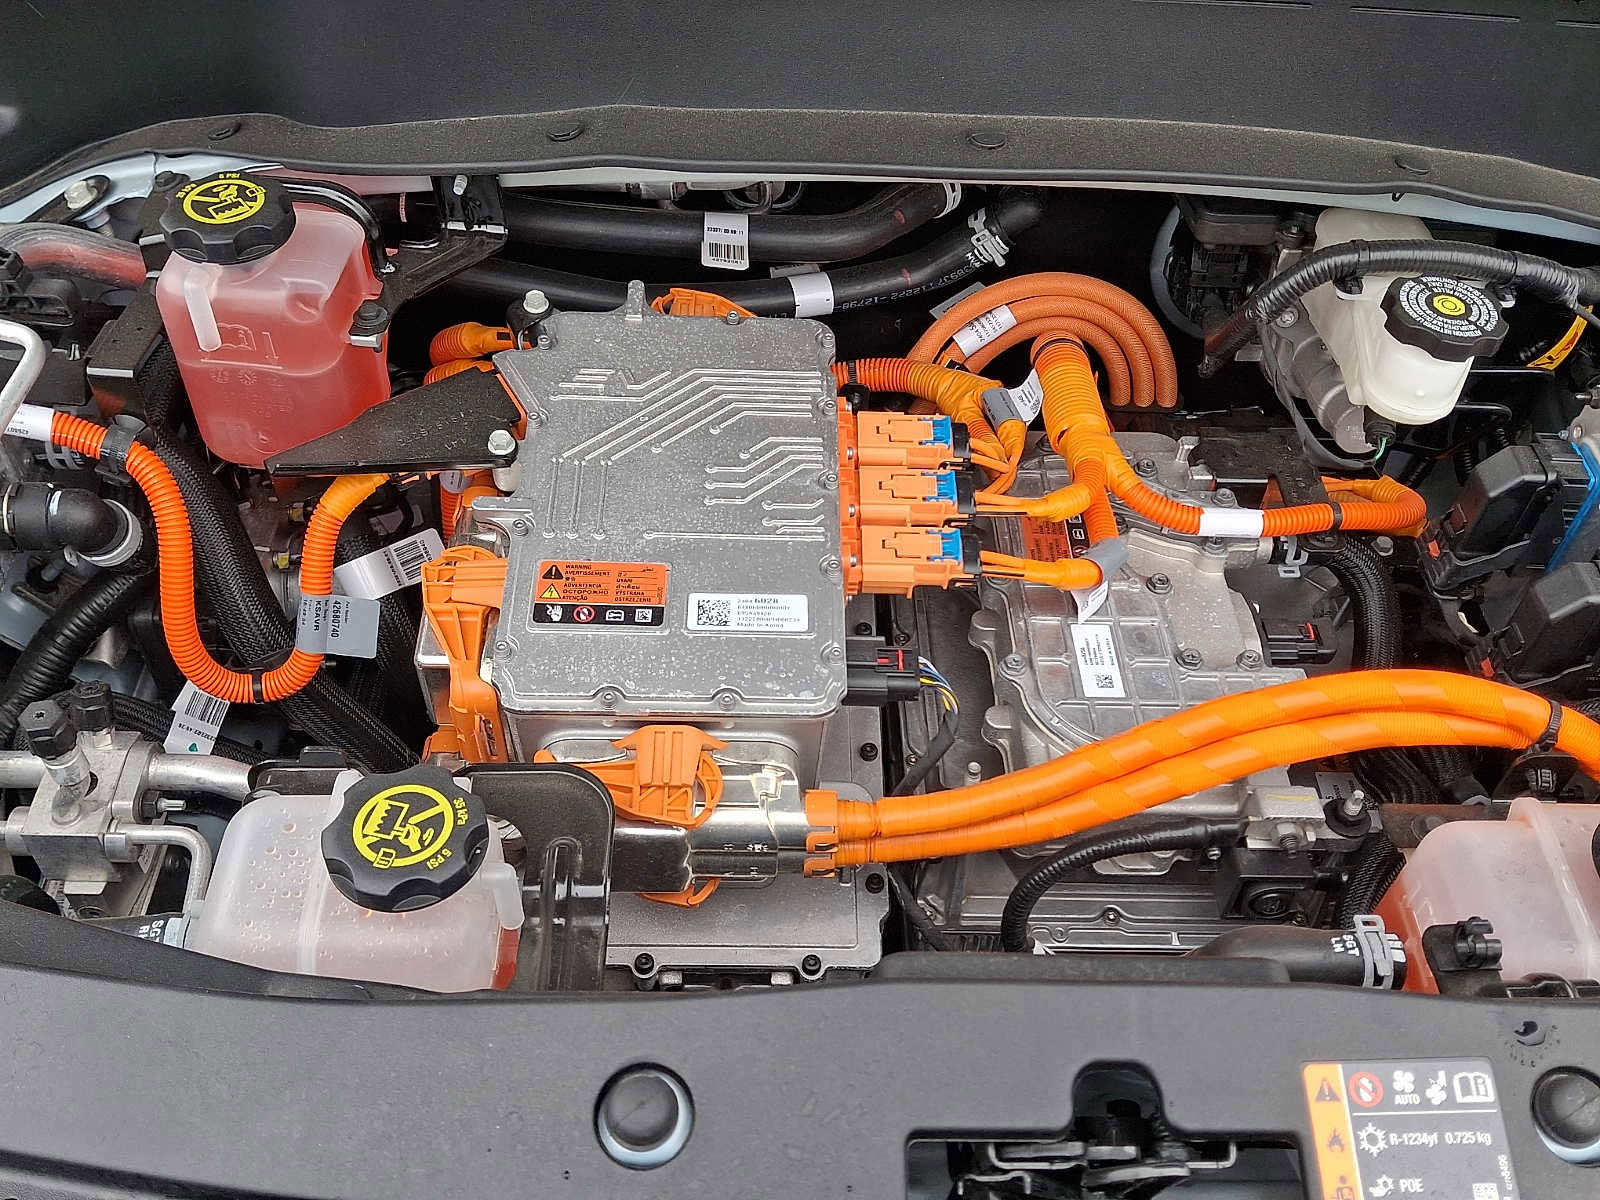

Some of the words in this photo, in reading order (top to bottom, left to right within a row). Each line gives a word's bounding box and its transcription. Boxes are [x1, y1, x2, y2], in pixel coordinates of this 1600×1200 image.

[313, 600, 322, 632] KSAVR
[330, 600, 342, 638] 42680740
[453, 797, 465, 809] 35
[456, 808, 469, 825] kPa
[426, 854, 445, 869] PSI
[1394, 1093, 1421, 1105] AUTO
[1389, 1132, 1439, 1148] R-1234yf
[1445, 1131, 1476, 1145] 0.725
[1476, 1131, 1492, 1146] kg
[1400, 1178, 1424, 1193] POE
